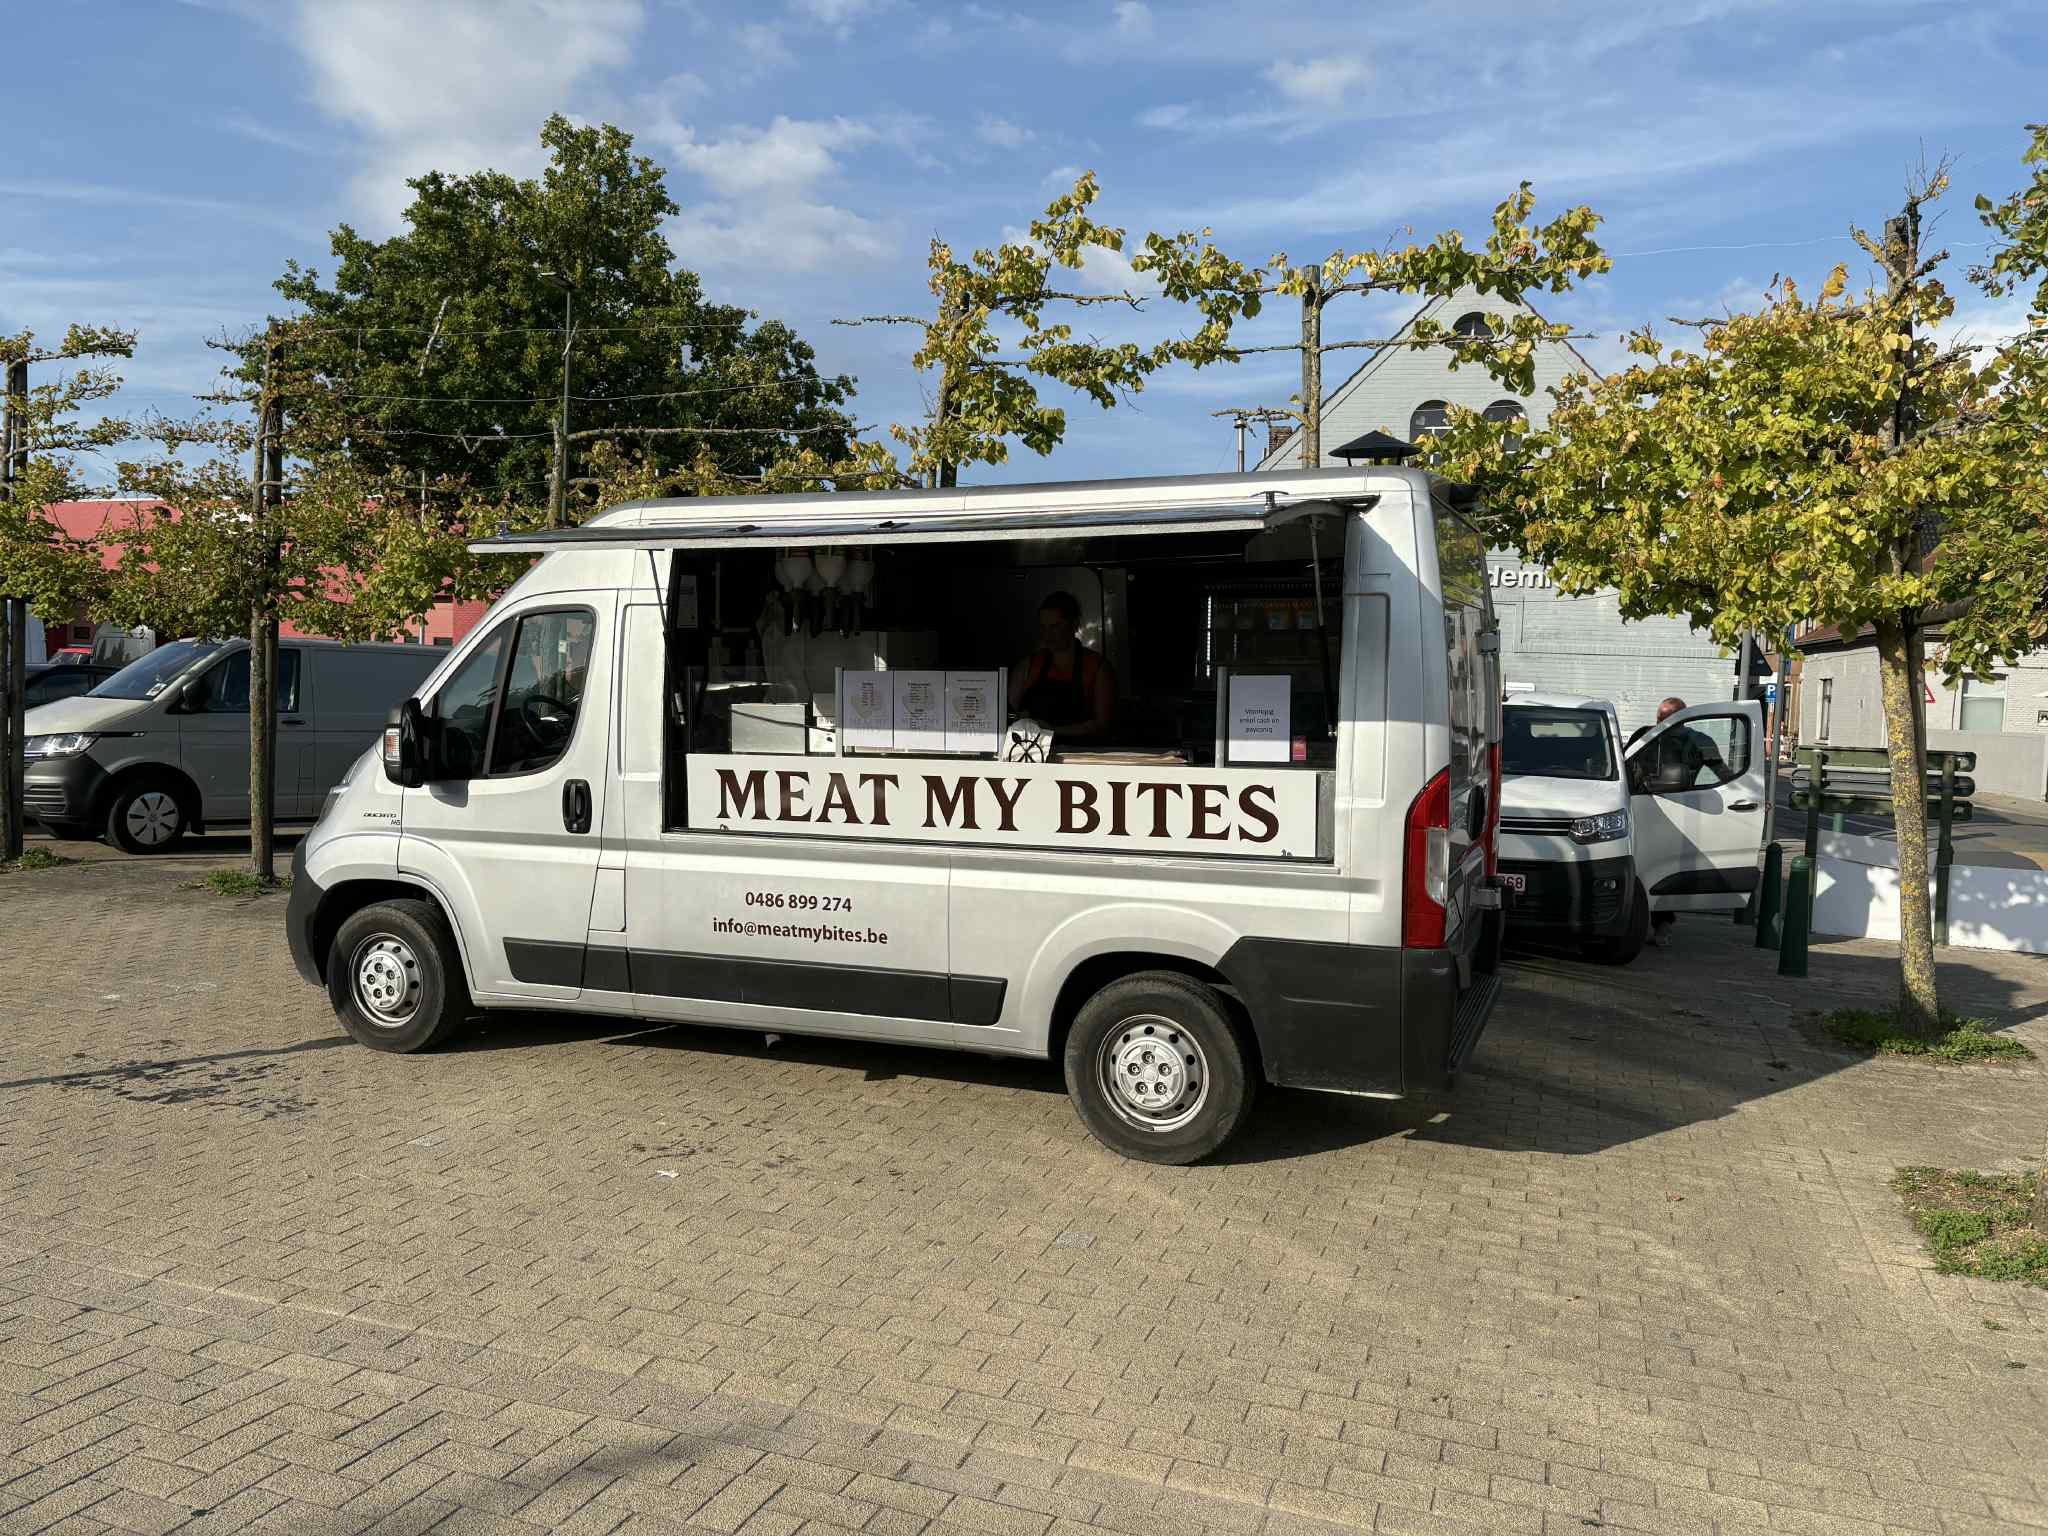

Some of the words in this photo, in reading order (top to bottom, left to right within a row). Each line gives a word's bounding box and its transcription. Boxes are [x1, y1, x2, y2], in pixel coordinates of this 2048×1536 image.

[1767, 684, 1776, 696] P
[715, 768, 900, 826] MEAT
[921, 775, 1033, 832] MY
[1054, 779, 1280, 843] BITES
[745, 891, 785, 908] 0486
[788, 894, 818, 910] 899
[821, 896, 853, 913] 274
[712, 917, 889, 944] info@meatmybites.be
